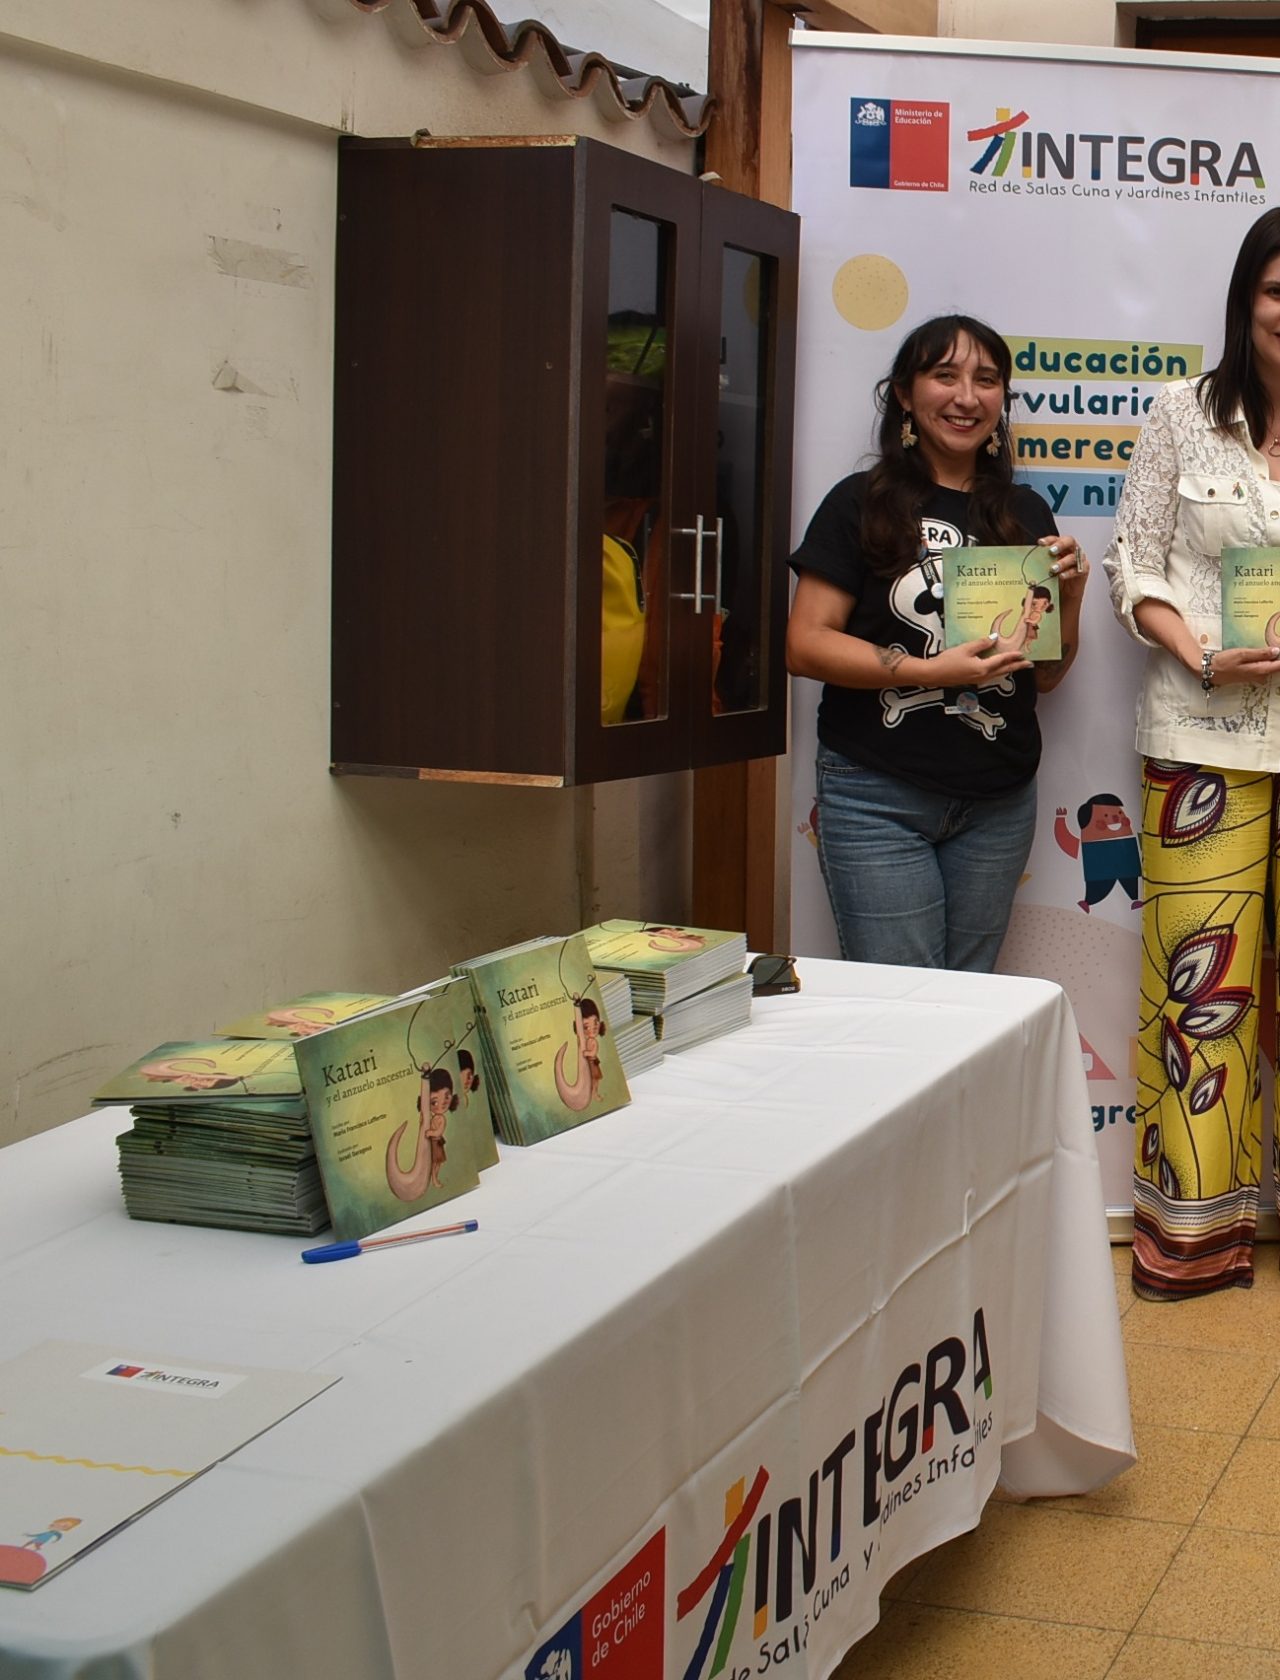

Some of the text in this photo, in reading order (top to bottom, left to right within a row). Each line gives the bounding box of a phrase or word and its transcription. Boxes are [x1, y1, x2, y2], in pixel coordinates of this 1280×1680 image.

[895, 108, 932, 118] Ministerio
[895, 117, 932, 125] Educación
[1022, 131, 1266, 189] INTEGRA
[894, 180, 920, 188] Gobierno
[969, 180, 1266, 205] Red de Salas Cuna y Jardines Infantiles
[1015, 341, 1187, 377] ducación
[1047, 484, 1070, 514] y
[957, 564, 998, 577] Katari
[1234, 564, 1274, 577] Katari
[497, 978, 540, 1009] Katari
[321, 1049, 378, 1088] Katari
[333, 1090, 340, 1102] el
[342, 1079, 375, 1099] anzuelo
[376, 1064, 414, 1087] ancestral
[152, 1374, 220, 1388] INTEGRA
[753, 1306, 993, 1640] INTEGRA
[813, 1562, 850, 1622] Cuna
[863, 1540, 874, 1572] y
[592, 1571, 651, 1639] Gobierno
[592, 1603, 646, 1668] de Chile
